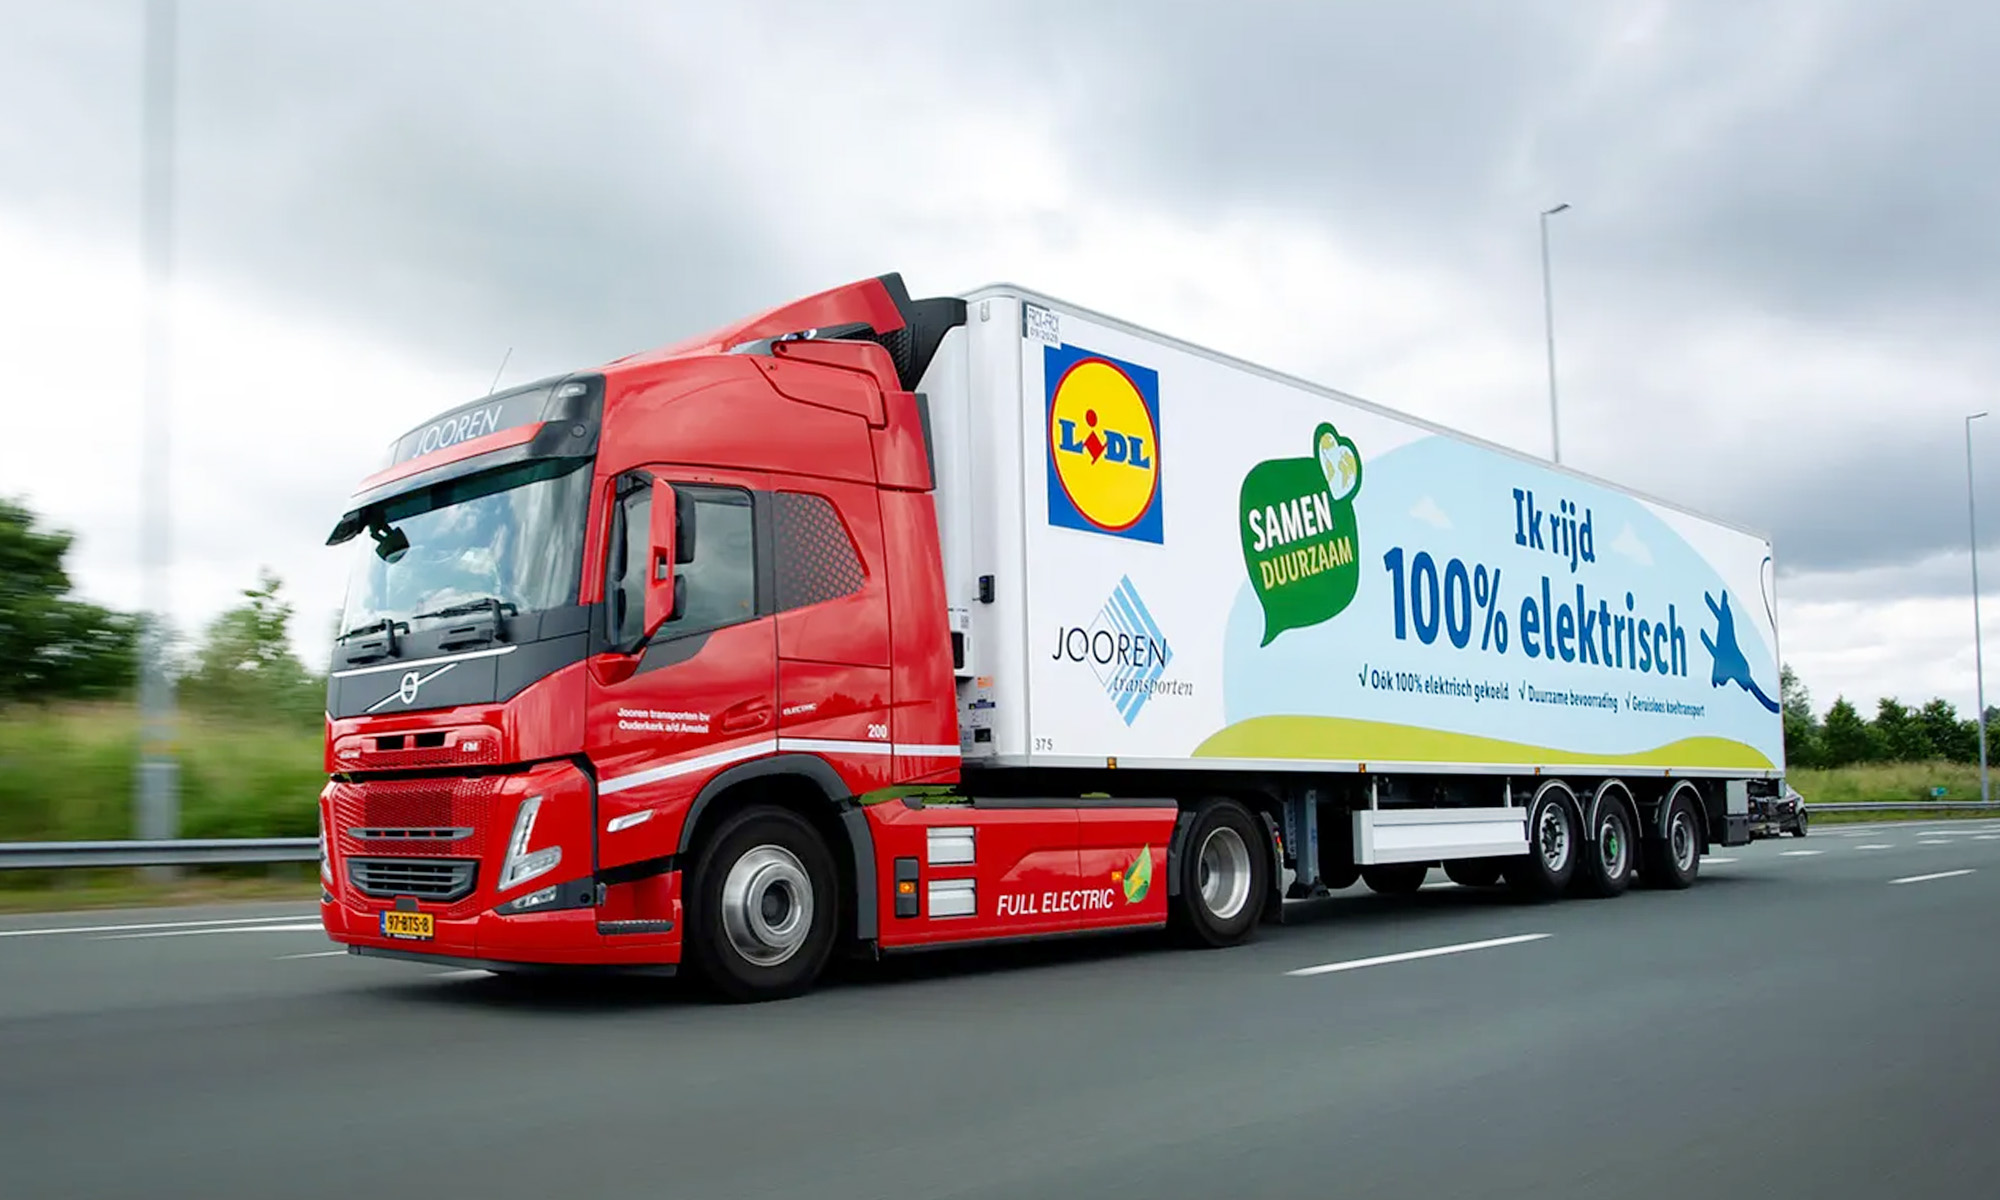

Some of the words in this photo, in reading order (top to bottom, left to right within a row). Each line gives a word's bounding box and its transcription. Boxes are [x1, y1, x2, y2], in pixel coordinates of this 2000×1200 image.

[412, 405, 503, 458] JOOREN
[1249, 491, 1333, 552] SAMEN
[1513, 488, 1545, 550] Ik
[1550, 499, 1595, 573] rijd
[1260, 536, 1353, 590] DUURZAAM
[1383, 546, 1508, 654] 100%
[1520, 576, 1688, 677] elektrisch
[1052, 627, 1166, 668] JOOREN
[1114, 675, 1193, 701] transporten
[1395, 672, 1423, 693] 100%
[1424, 675, 1472, 697] elektrisch
[1474, 681, 1509, 703] gekoeld
[1528, 685, 1568, 706] Duurzame
[1570, 689, 1618, 713] bevoorrading
[617, 707, 649, 717] Jooren
[650, 709, 698, 721] transporten
[699, 711, 710, 721] bv
[619, 720, 664, 731] Ouderkerk
[680, 723, 709, 733] Amstel
[868, 724, 887, 738] 200
[1035, 738, 1053, 750] 375
[997, 894, 1035, 916] FULL
[1042, 888, 1114, 913] ELECTRIC
